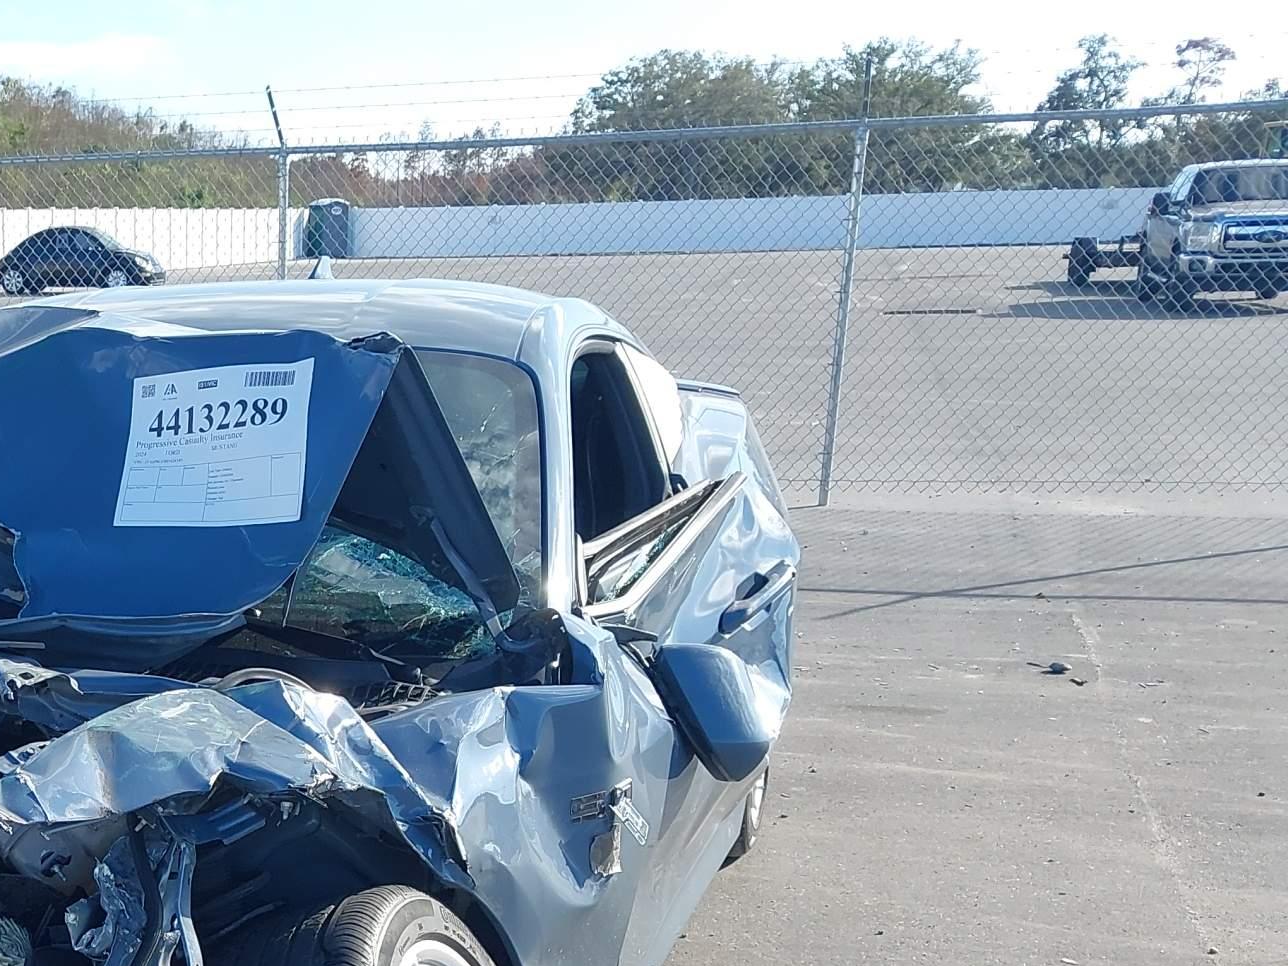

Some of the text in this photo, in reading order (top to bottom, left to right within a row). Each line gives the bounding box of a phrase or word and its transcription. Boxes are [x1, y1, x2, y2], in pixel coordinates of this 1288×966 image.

[148, 397, 288, 438] 44132289
[135, 432, 244, 450] Progressive Casualty Insurance
